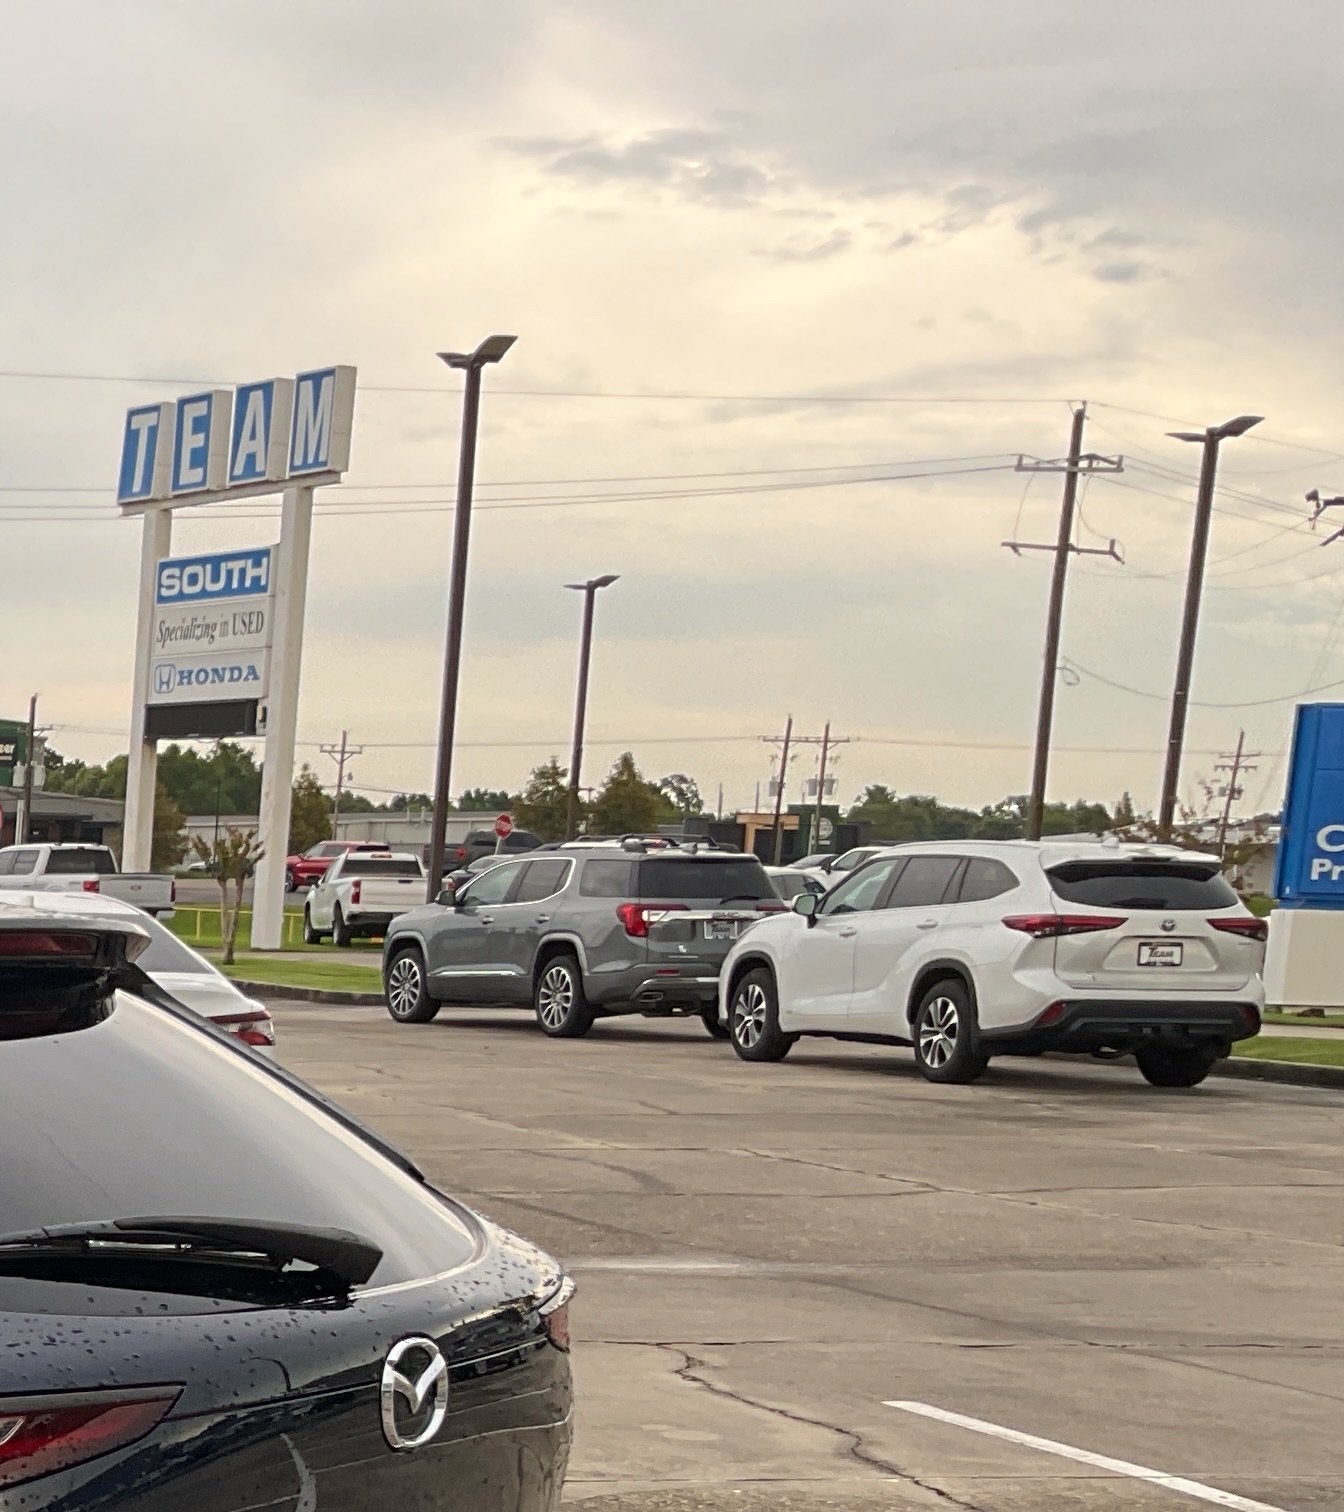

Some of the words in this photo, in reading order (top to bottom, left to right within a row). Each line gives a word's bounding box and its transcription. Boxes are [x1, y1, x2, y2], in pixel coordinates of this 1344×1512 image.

[130, 375, 335, 494] TEAM
[160, 557, 268, 597] SOUTH
[156, 615, 218, 648] Specializing
[219, 612, 229, 637] in
[232, 610, 264, 636] USED
[177, 664, 260, 686] HONDA
